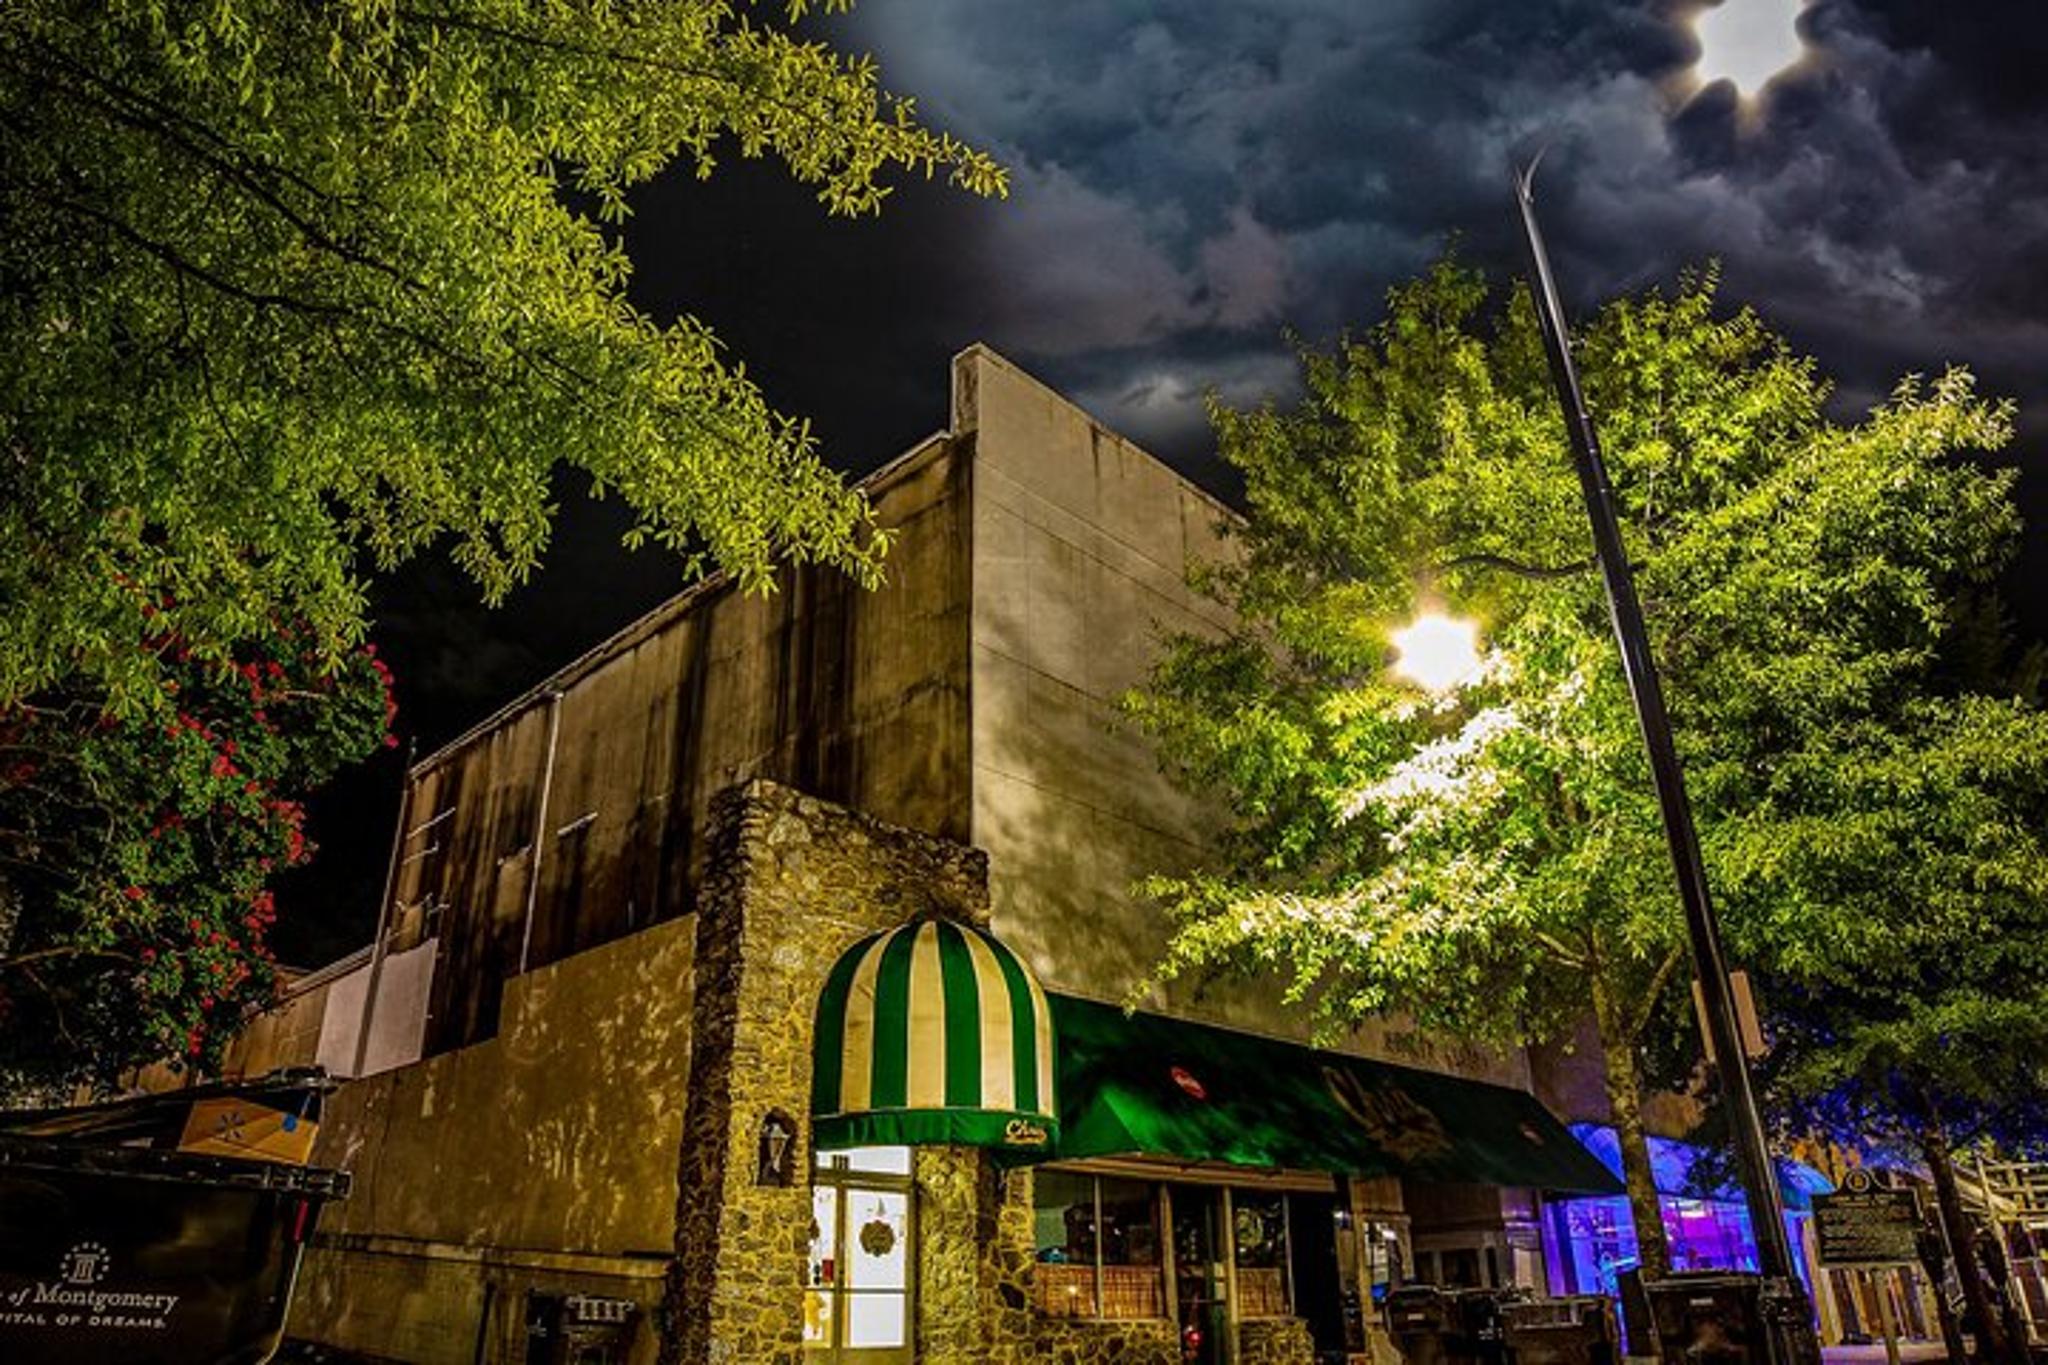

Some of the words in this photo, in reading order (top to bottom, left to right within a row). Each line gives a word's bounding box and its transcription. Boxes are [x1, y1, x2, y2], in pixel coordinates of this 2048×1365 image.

[7, 1287, 31, 1307] of
[33, 1281, 180, 1315] Montgomery
[55, 1313, 82, 1327] OF
